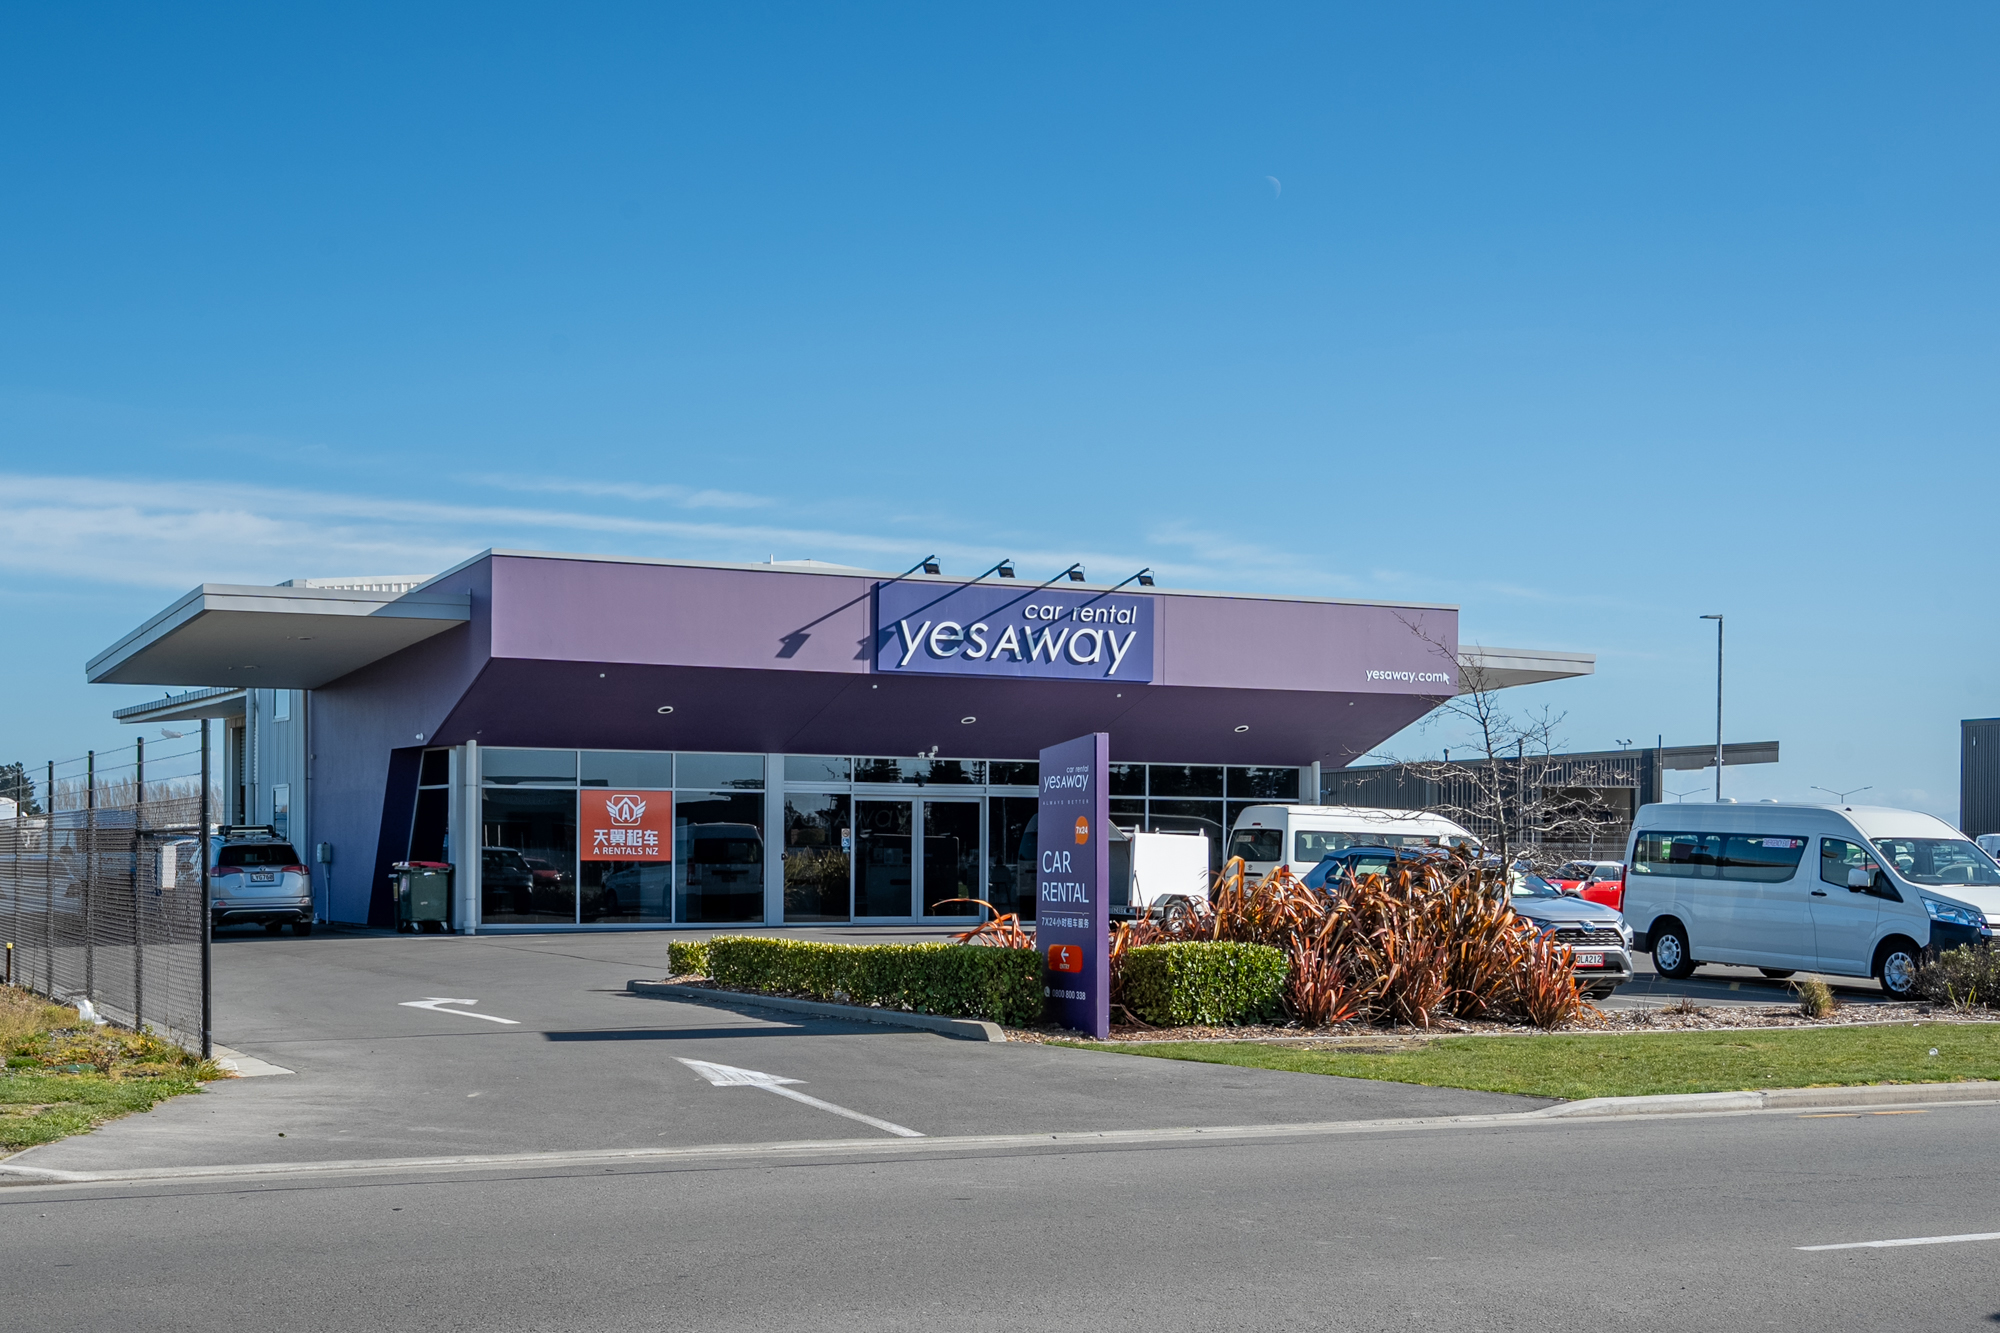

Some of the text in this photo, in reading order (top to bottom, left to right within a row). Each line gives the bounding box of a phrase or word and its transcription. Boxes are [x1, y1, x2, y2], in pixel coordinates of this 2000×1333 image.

[1024, 604, 1137, 624] car rental
[1365, 669, 1443, 684] yesaway.com
[1075, 765, 1090, 773] rental
[593, 829, 659, 846] 天翼租车
[593, 847, 659, 855] A RENTALS NZ
[1042, 850, 1072, 873] CAR
[1041, 882, 1090, 903] RENTAL
[1052, 989, 1086, 1001] 0800 800 338
